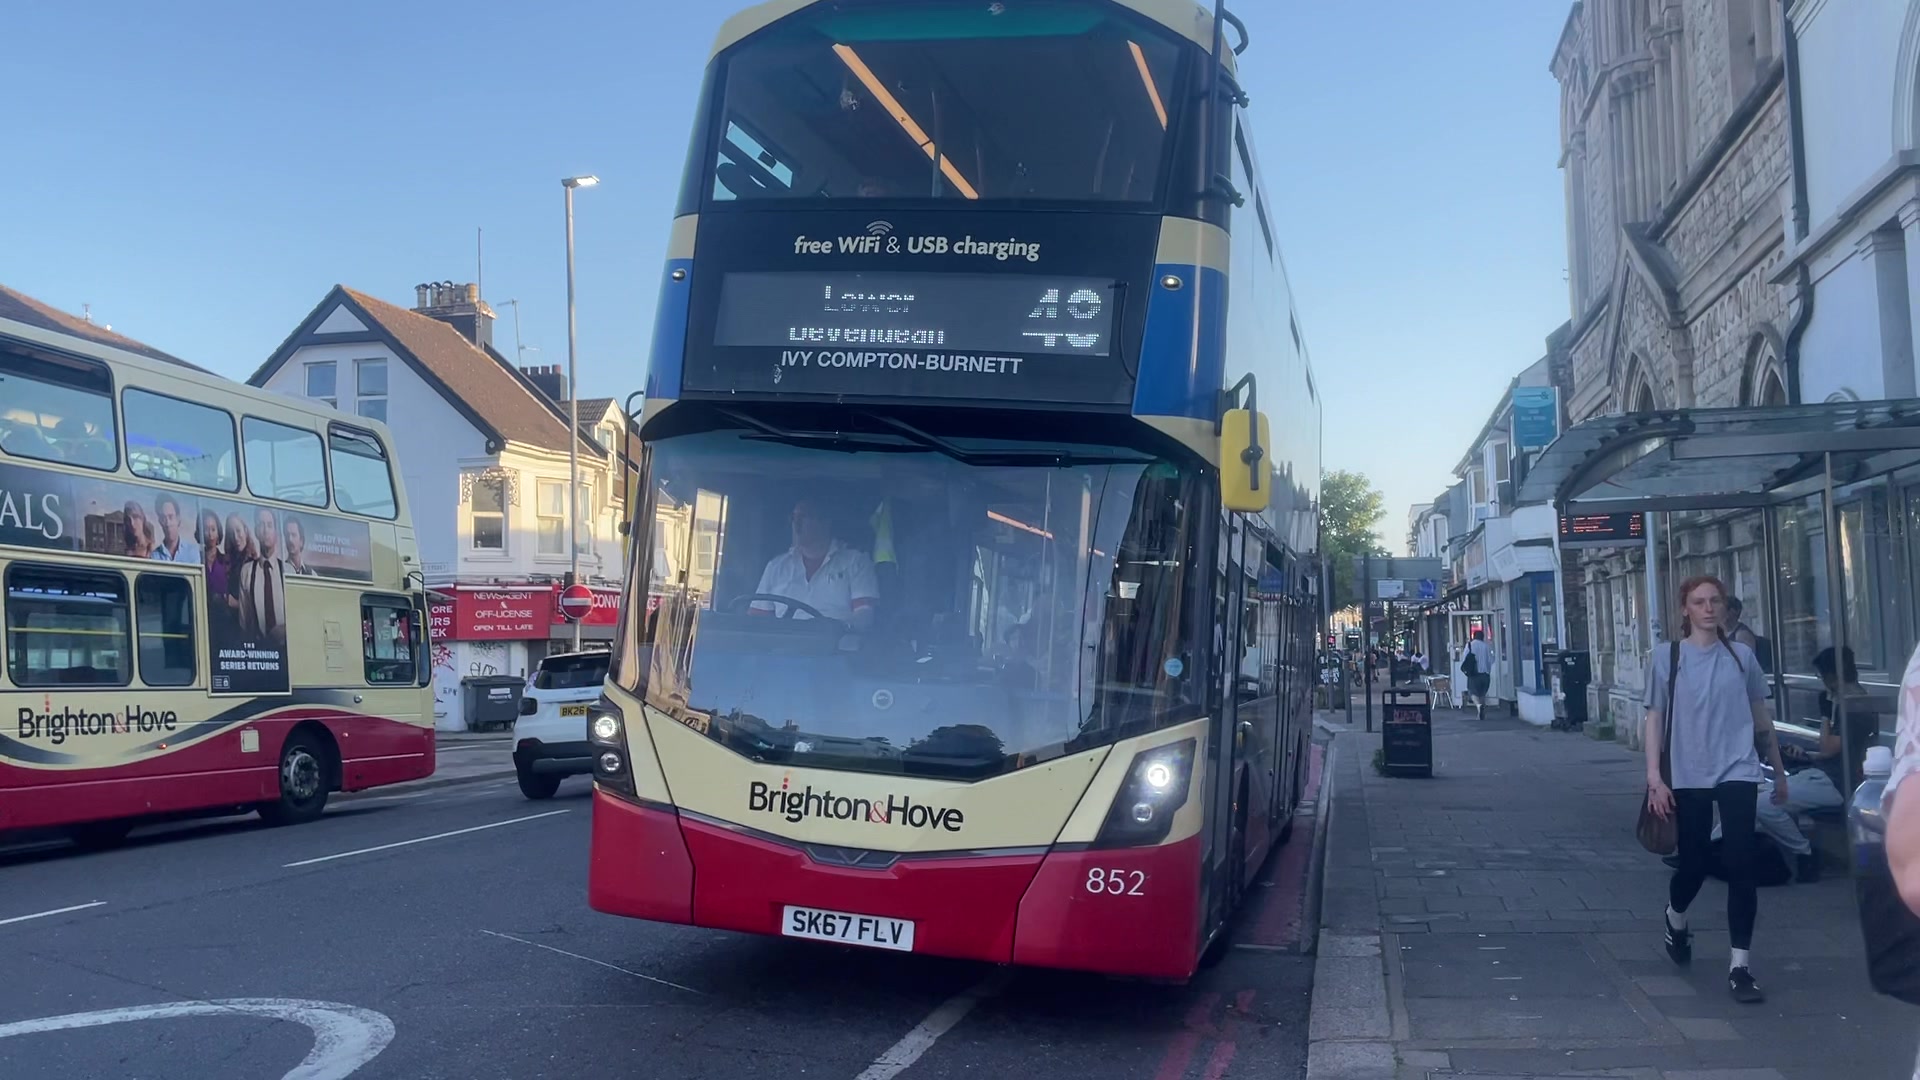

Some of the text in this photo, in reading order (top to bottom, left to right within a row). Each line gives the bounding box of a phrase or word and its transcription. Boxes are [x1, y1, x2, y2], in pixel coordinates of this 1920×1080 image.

[794, 235, 1041, 262] free WiFi & USB charging
[781, 350, 1023, 375] IVY COMPTON-BURNETT
[0, 489, 63, 540] ALS
[431, 605, 454, 614] ORE
[474, 610, 534, 619] OFF-LICENSE
[515, 623, 534, 631] LATE
[218, 649, 280, 660] AWARD-WINNING
[220, 661, 280, 671] SERIES RETURNS
[561, 705, 585, 717] BK26
[1086, 867, 1145, 896] 852
[792, 909, 904, 945] SK67 FLV
